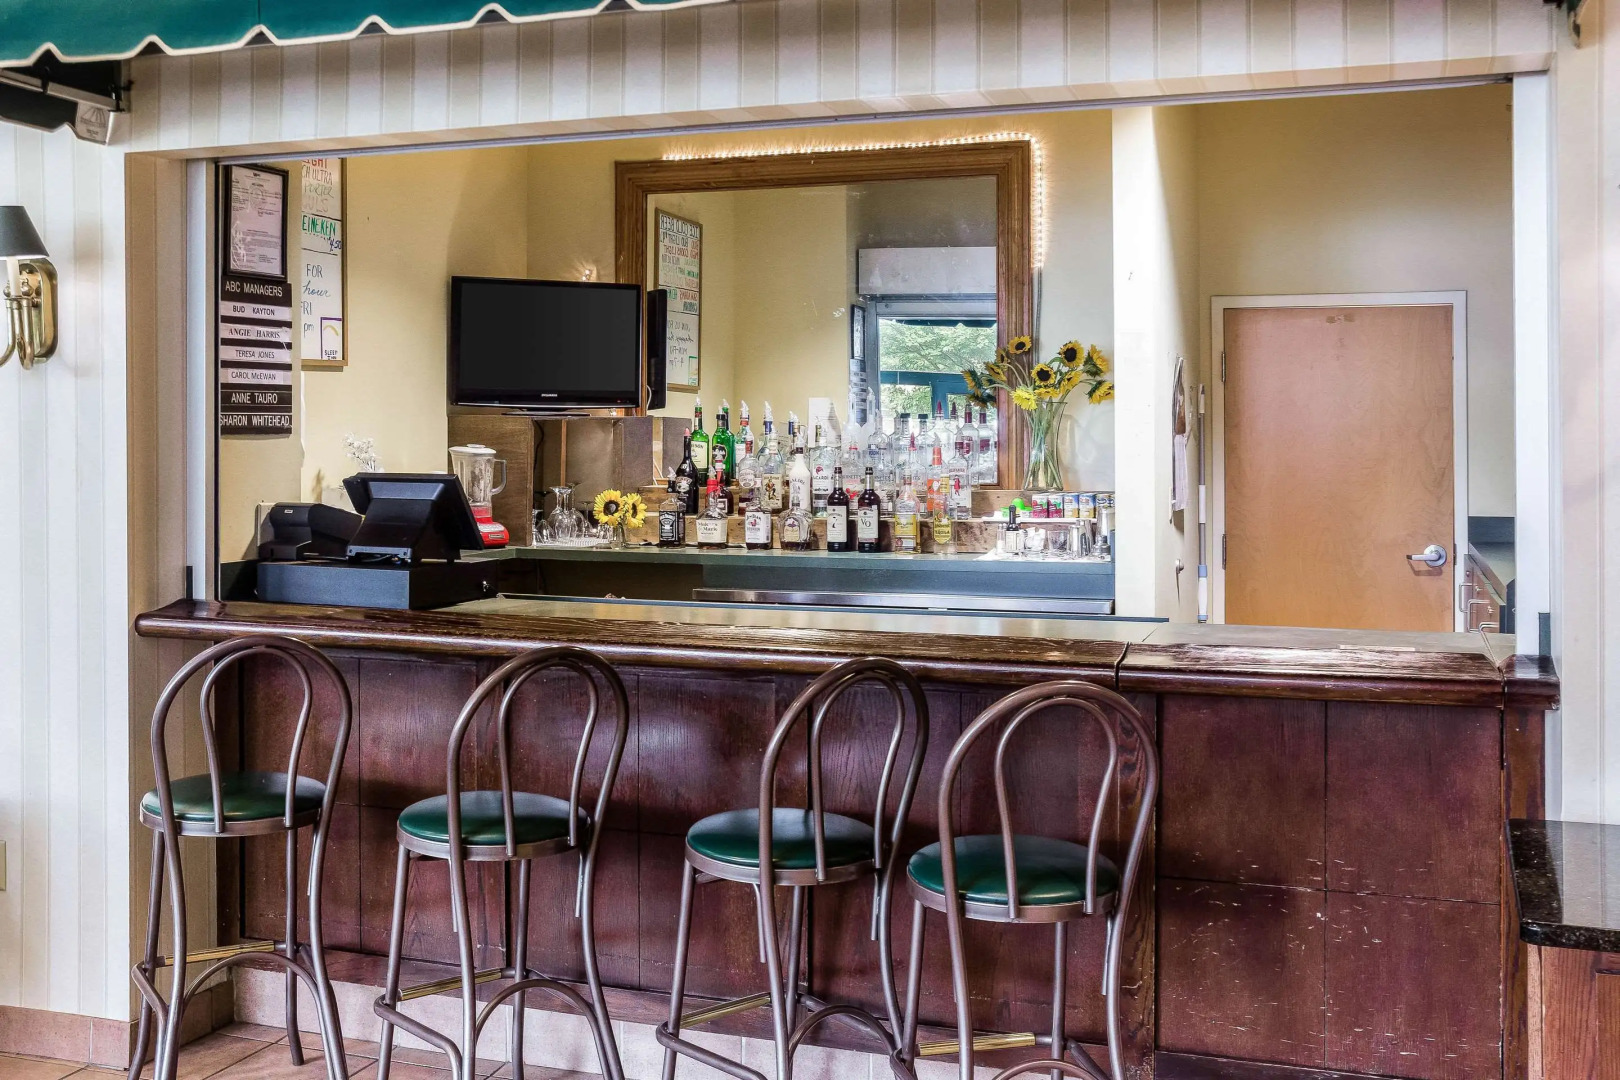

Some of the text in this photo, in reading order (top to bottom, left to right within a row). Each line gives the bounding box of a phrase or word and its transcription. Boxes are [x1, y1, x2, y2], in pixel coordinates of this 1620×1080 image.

[312, 169, 333, 186] ULTRA
[302, 214, 336, 236] EINEKEN
[306, 263, 323, 278] FOR
[225, 280, 283, 297] ABC MANAGERS
[302, 280, 331, 297] hour
[232, 305, 275, 316] BUD KAYTON
[301, 300, 312, 315] RI
[228, 328, 281, 339] ANGIE HARRIS
[235, 349, 275, 360] TERESA JONES
[231, 371, 250, 380] CAROL
[231, 392, 278, 404] ANNE TAURO
[220, 414, 290, 427] SHARON WHITEHEAD
